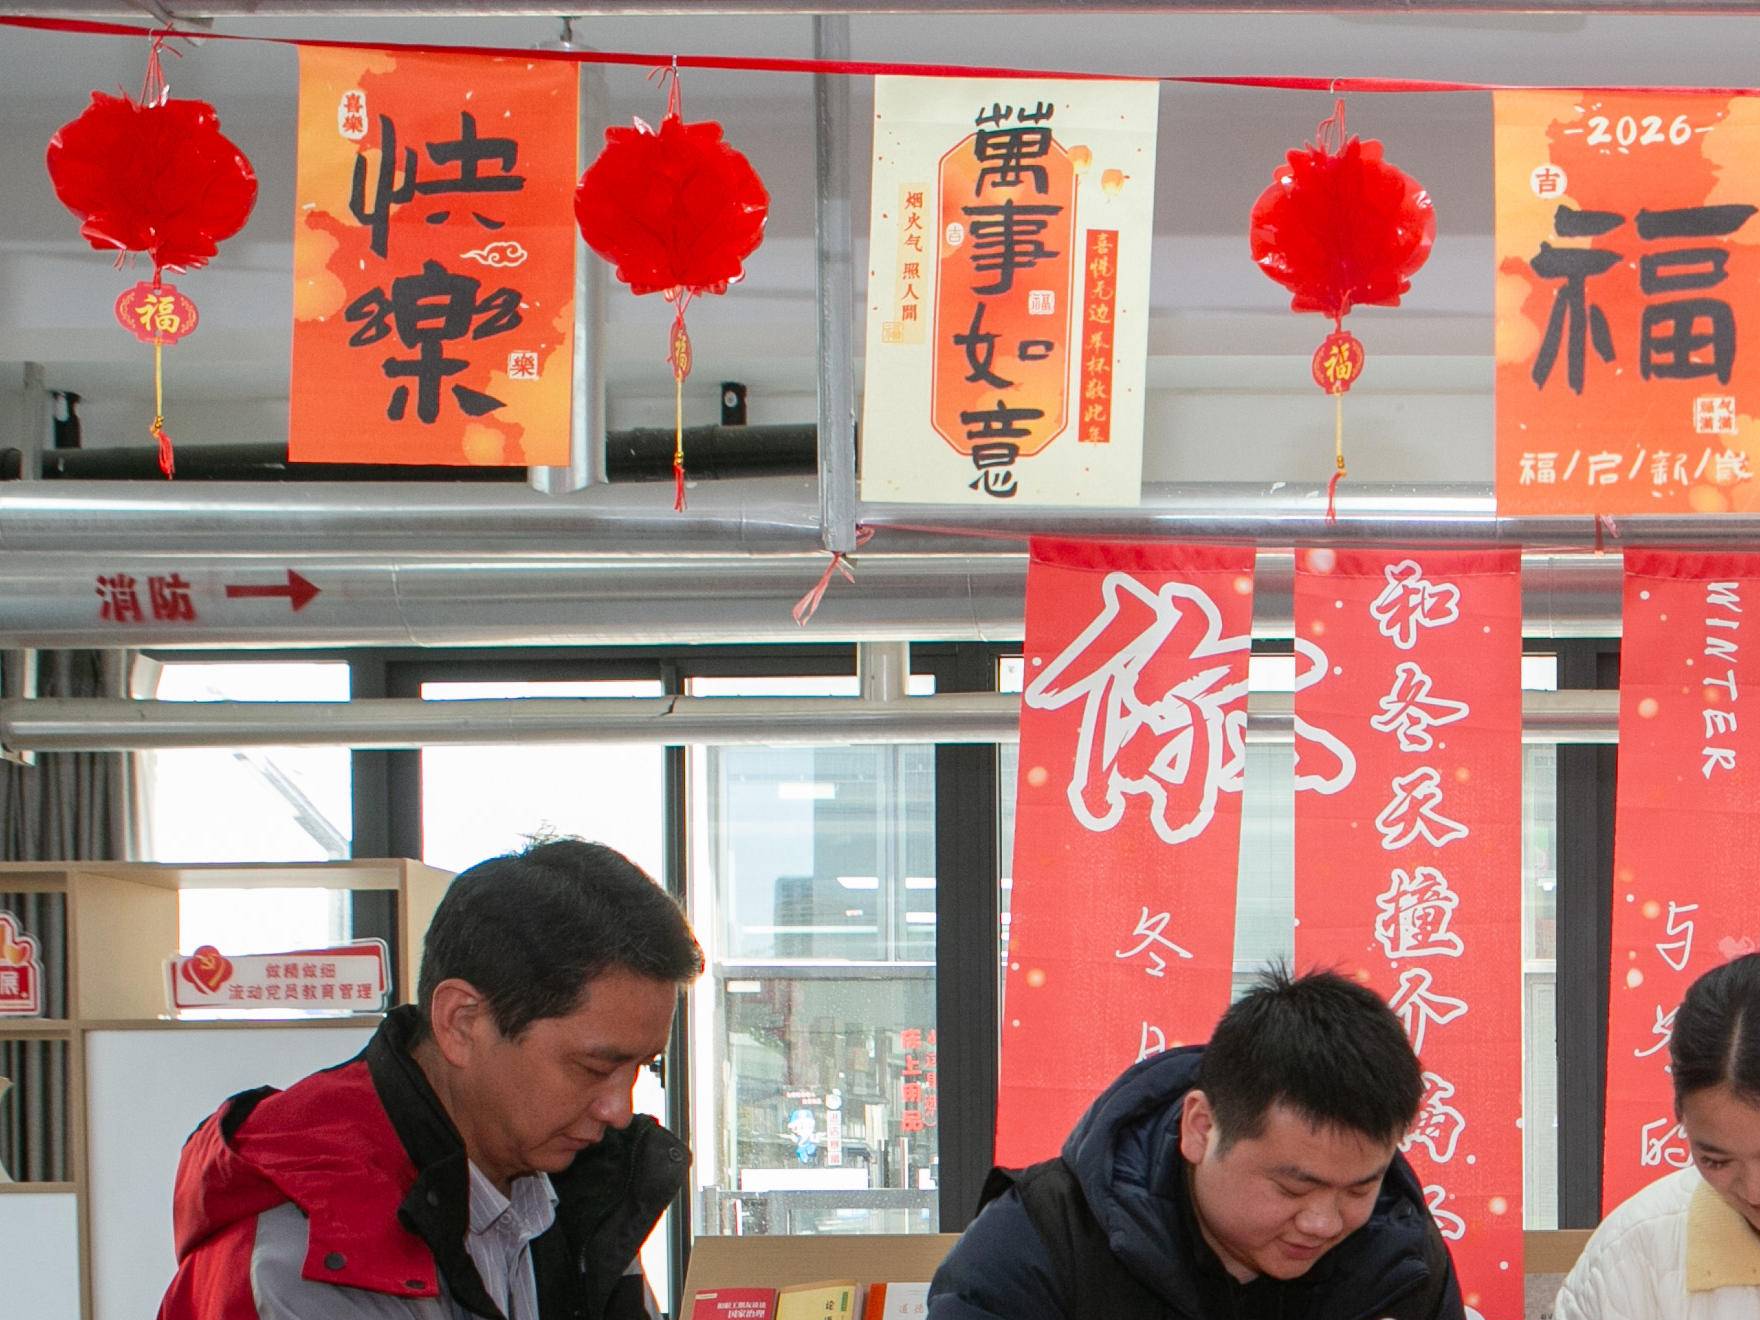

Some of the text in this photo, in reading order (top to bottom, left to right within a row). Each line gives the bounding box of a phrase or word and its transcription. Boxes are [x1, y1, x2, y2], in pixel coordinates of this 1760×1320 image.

[1536, 168, 1560, 193] 吉
[345, 110, 527, 424] 快樂
[135, 293, 180, 333] 福
[954, 101, 1064, 498] 萬事如意
[1530, 204, 1760, 395] 福
[1323, 340, 1354, 383] 福
[97, 573, 197, 624] 消防
[1701, 581, 1743, 780] WINTER
[228, 983, 373, 1001] 流动党员教育管理
